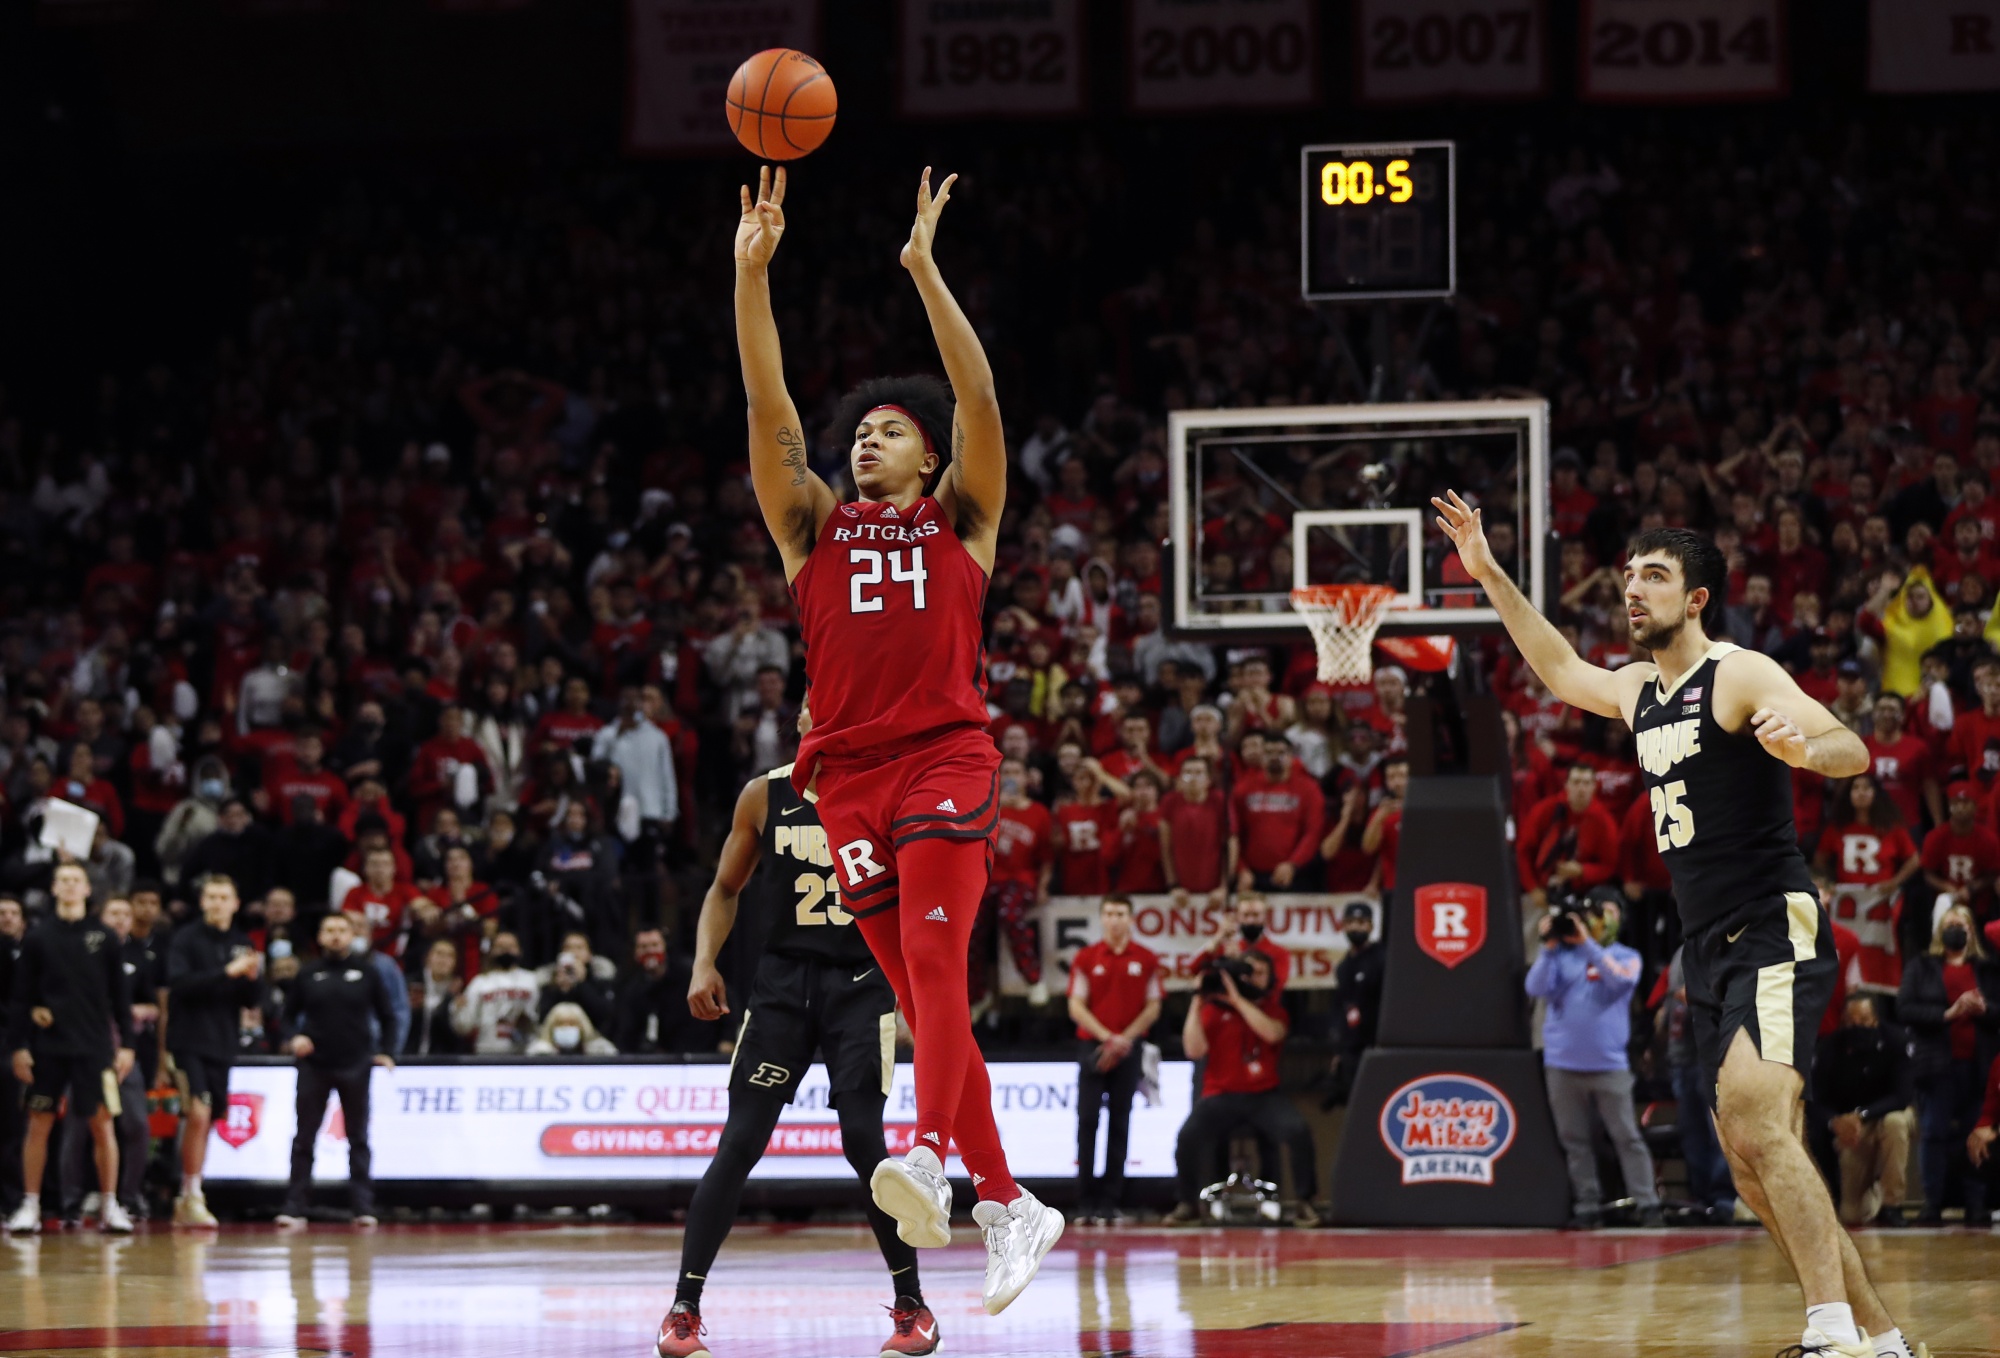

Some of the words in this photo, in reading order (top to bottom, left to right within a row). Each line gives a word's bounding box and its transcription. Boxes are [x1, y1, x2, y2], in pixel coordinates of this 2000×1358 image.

[920, 32, 1066, 87] 1982
[1142, 23, 1303, 79] 2000
[1373, 12, 1531, 69] 2007
[1594, 17, 1772, 68] 2014
[1321, 159, 1414, 205] 00.5
[850, 546, 928, 614] 24
[1635, 718, 1702, 778] PURDUE
[1068, 820, 1101, 852] R
[1650, 779, 1696, 854] 25
[775, 825, 834, 868] PUR
[838, 838, 888, 888] R
[1842, 834, 1882, 874] R
[1948, 855, 1974, 882] R
[794, 872, 855, 927] 23
[1432, 902, 1471, 938] R
[749, 1062, 790, 1088] P
[228, 1105, 253, 1128] R
[398, 1086, 464, 1113] THE
[476, 1086, 572, 1113] BELLS
[583, 1086, 625, 1113] OF
[1399, 1092, 1496, 1127] Jersey
[1409, 1160, 1484, 1177] ARENA
